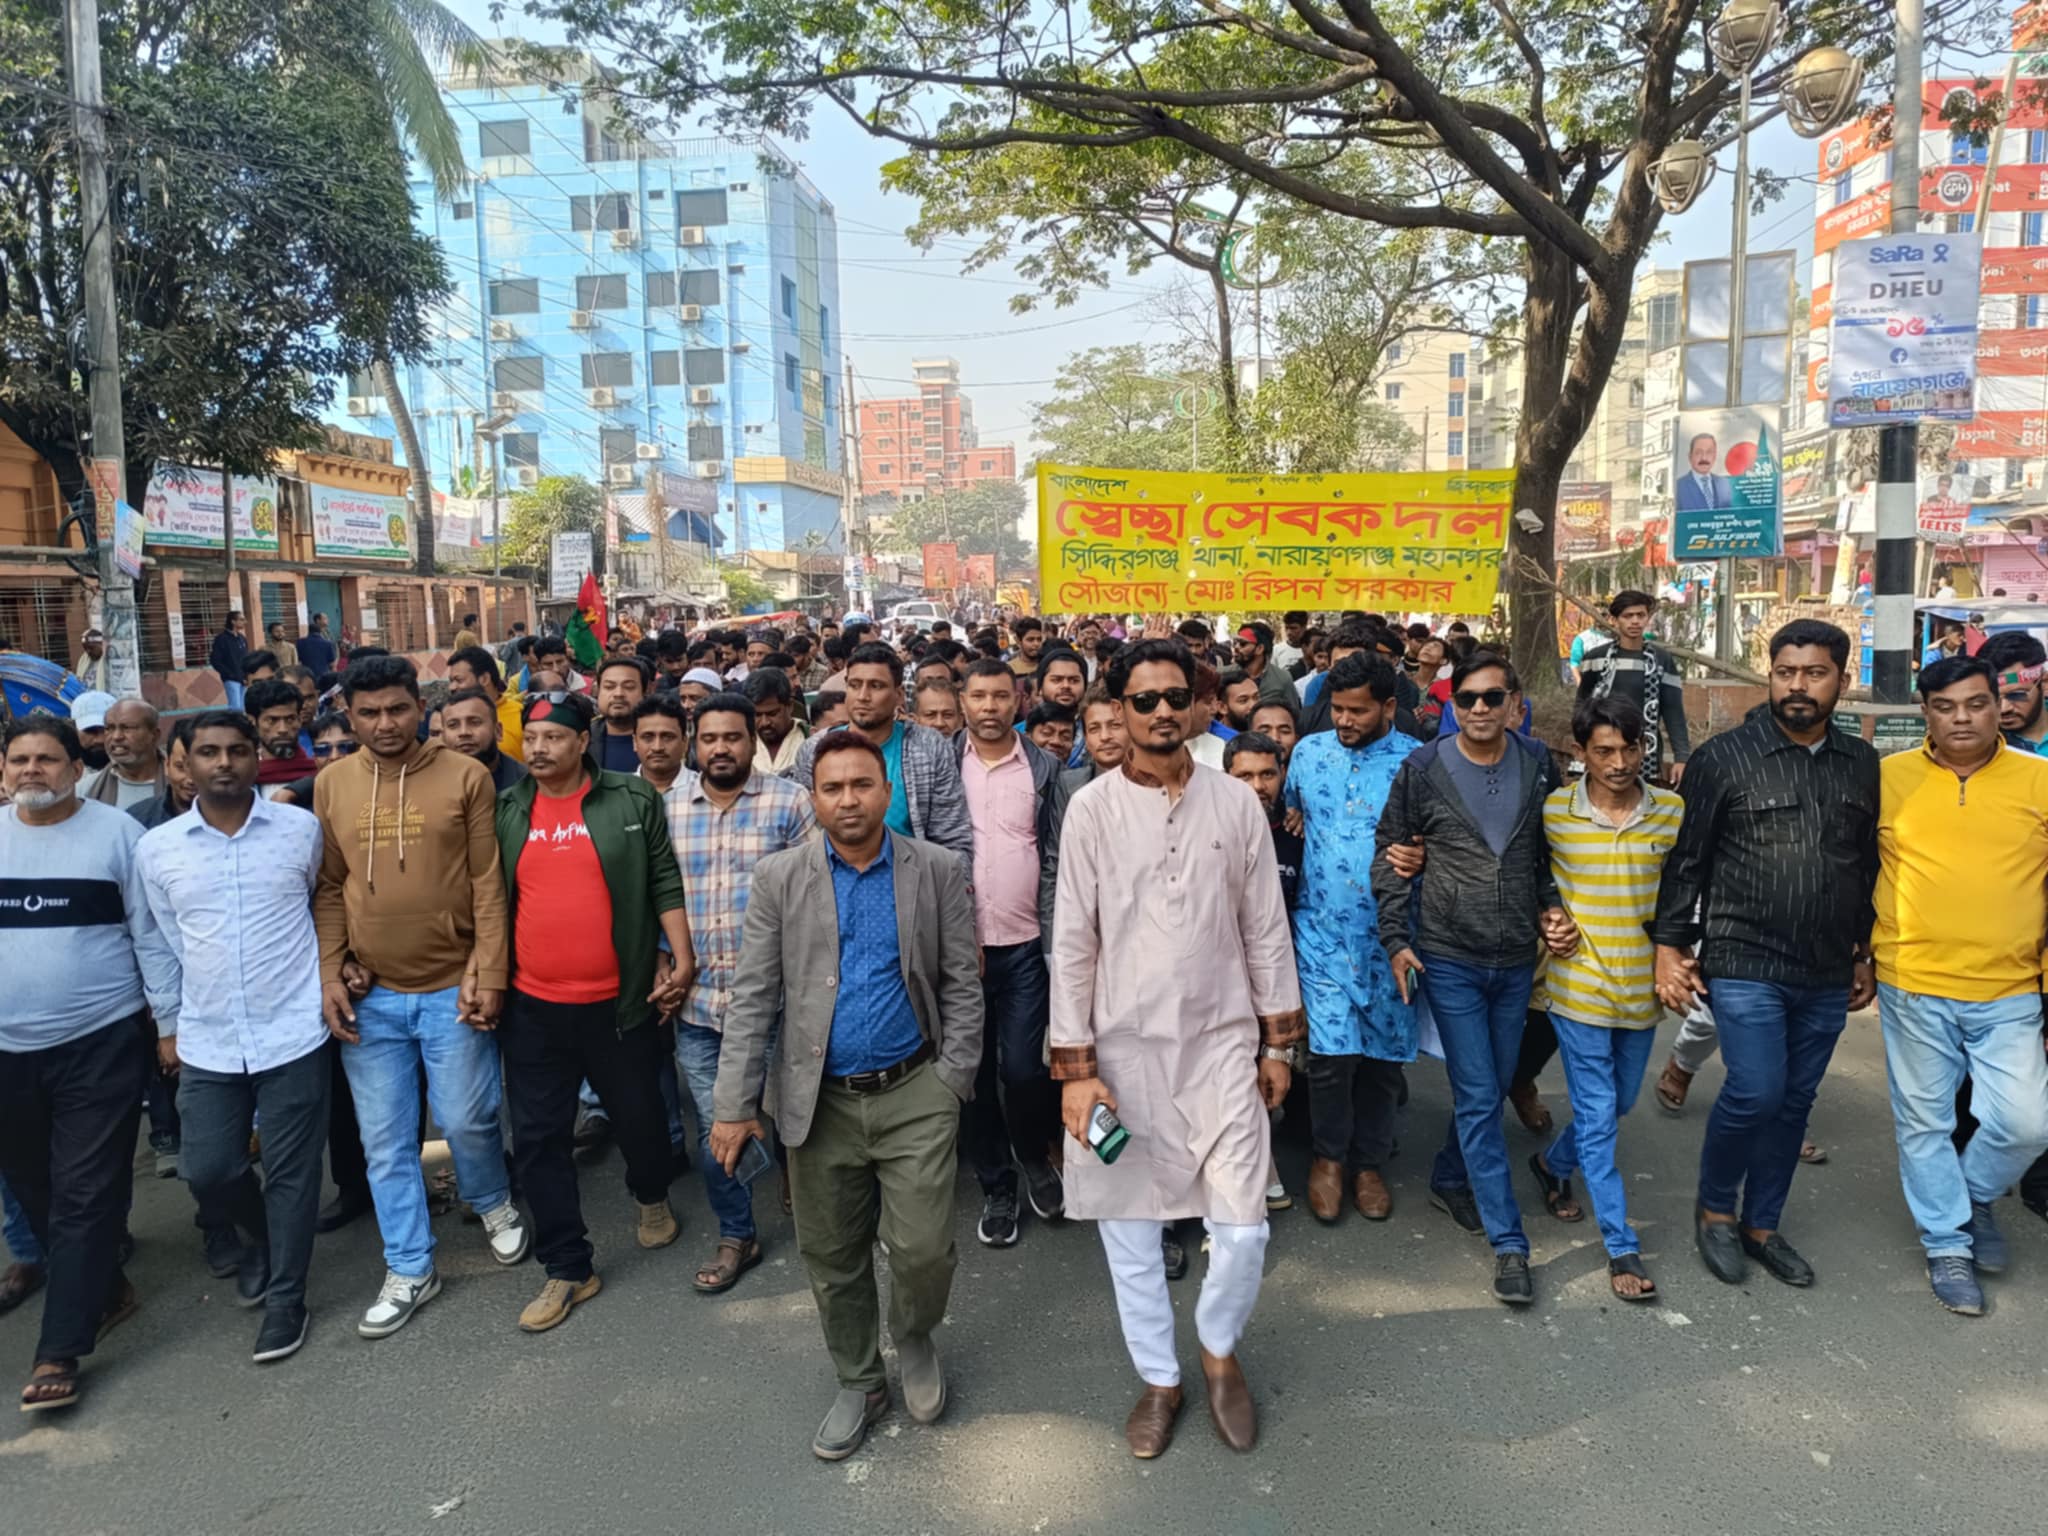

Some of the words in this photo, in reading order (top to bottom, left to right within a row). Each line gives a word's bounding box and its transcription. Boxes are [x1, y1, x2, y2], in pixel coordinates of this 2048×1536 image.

[1869, 244, 1924, 264] SaRa
[1869, 279, 1943, 299] DHEU
[1886, 317, 1926, 337] ১৫
[1961, 428, 1996, 446] ispat
[1048, 473, 1129, 497] বাংলাদেশ
[1056, 500, 1188, 546] স্বেচ্ছা
[1919, 519, 1963, 534] IELTS
[1193, 545, 1249, 569] থানা,
[1256, 545, 1395, 569] নারায়ণগঞ্জ
[1402, 546, 1502, 571] মহানগর
[1242, 570, 1326, 601] রিপন
[1335, 578, 1457, 603] সরকার
